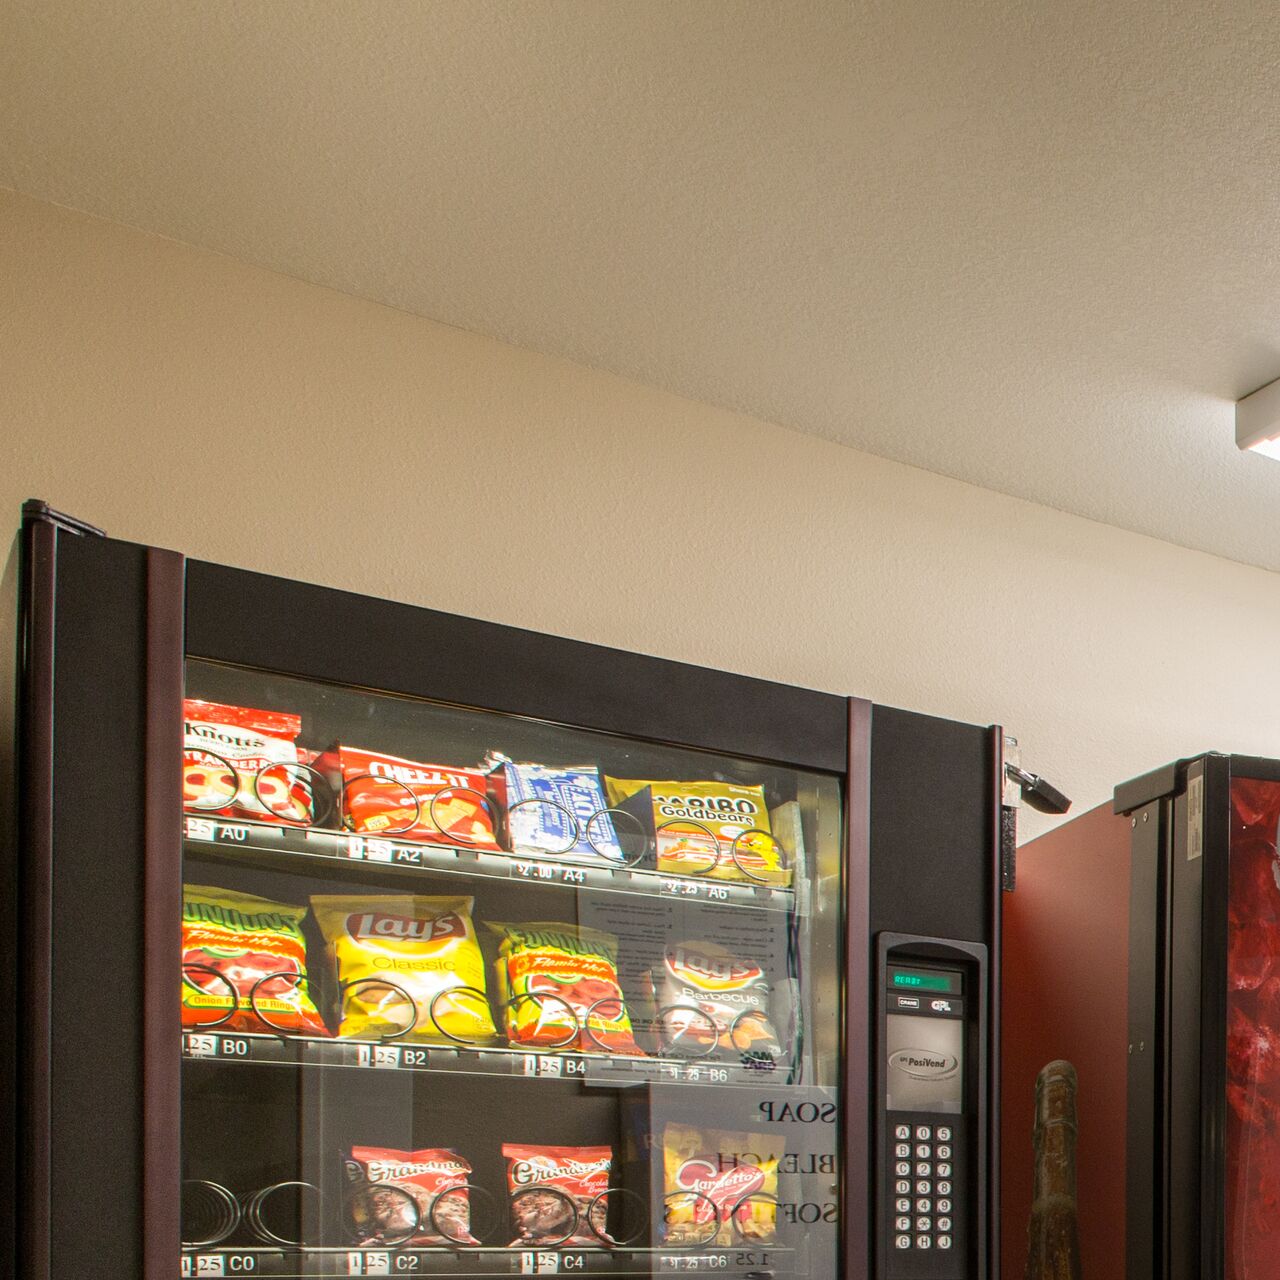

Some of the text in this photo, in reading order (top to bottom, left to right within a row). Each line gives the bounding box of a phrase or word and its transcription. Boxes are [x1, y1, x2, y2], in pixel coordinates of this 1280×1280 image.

[660, 805, 756, 827] Goldbears
[221, 825, 247, 841] A0
[398, 849, 420, 863] A2
[564, 867, 585, 882] A4
[708, 884, 728, 900] A6
[357, 913, 455, 942] Lay's
[372, 956, 456, 972] Classic
[682, 986, 760, 1005] Barbecue
[222, 1040, 248, 1056] B0
[361, 1050, 427, 1066] 1.25 B2
[908, 1057, 946, 1069] PosiVend
[528, 1058, 586, 1075] 1.25 B4
[709, 1068, 728, 1083] B6
[182, 1255, 255, 1272] 1.25 C0
[351, 1254, 419, 1271] 1.25 C2
[524, 1254, 584, 1270] 1.25 C4
[709, 1254, 728, 1269] C6
